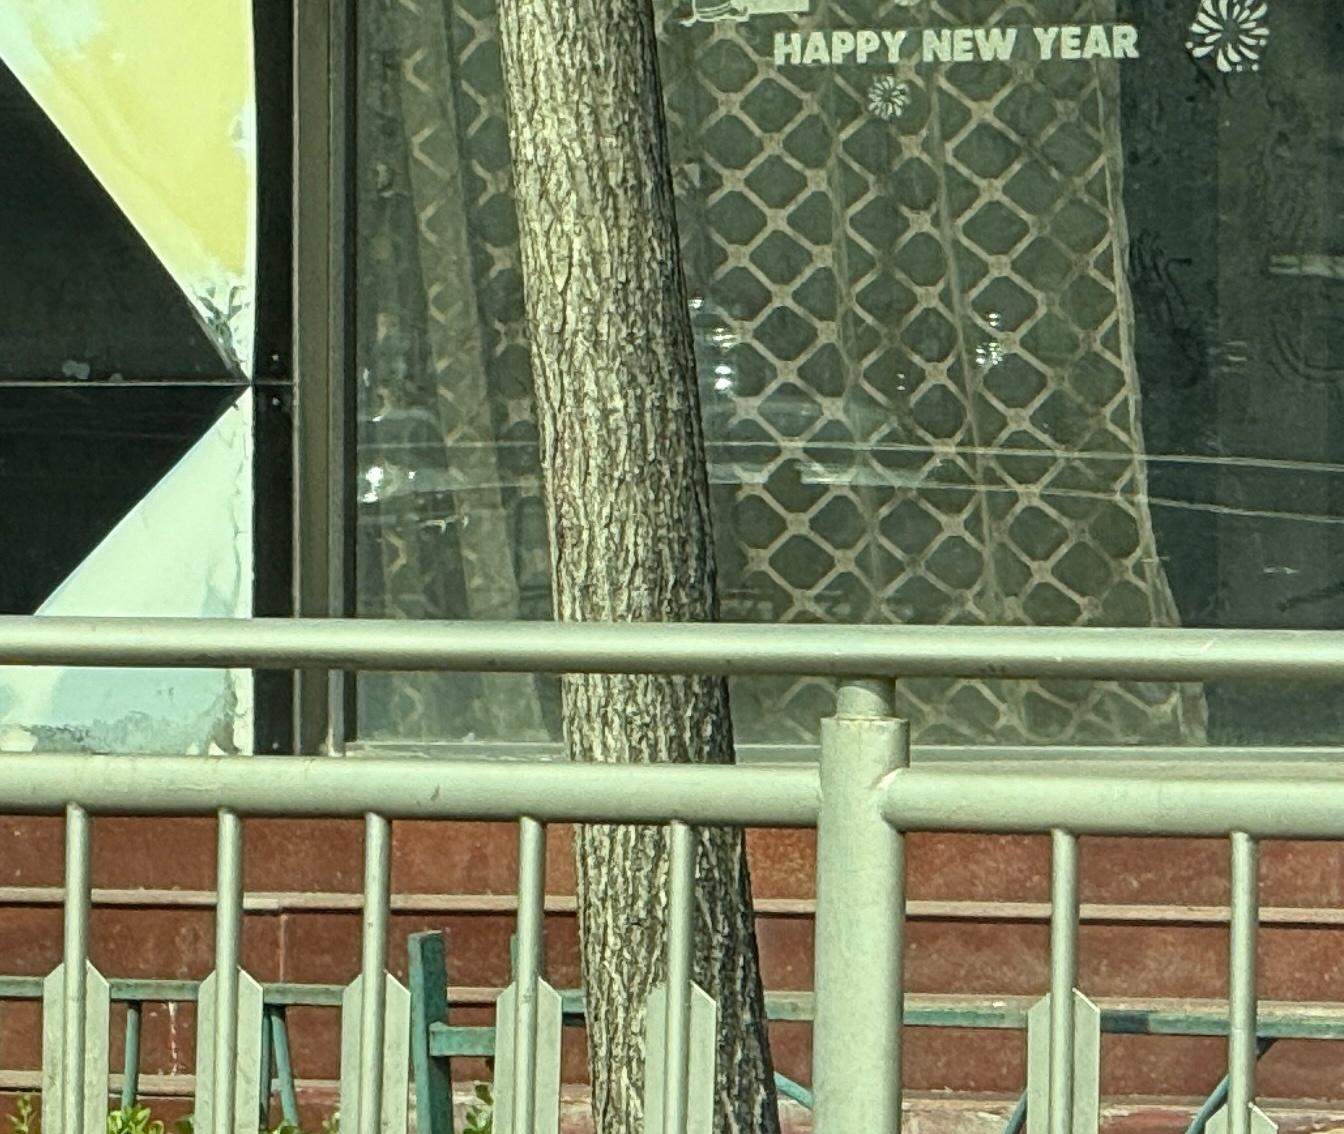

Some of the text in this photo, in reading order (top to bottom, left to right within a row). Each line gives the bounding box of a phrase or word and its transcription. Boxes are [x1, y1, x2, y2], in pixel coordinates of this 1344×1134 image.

[773, 24, 1140, 66] HAPPY NEW YEAR
